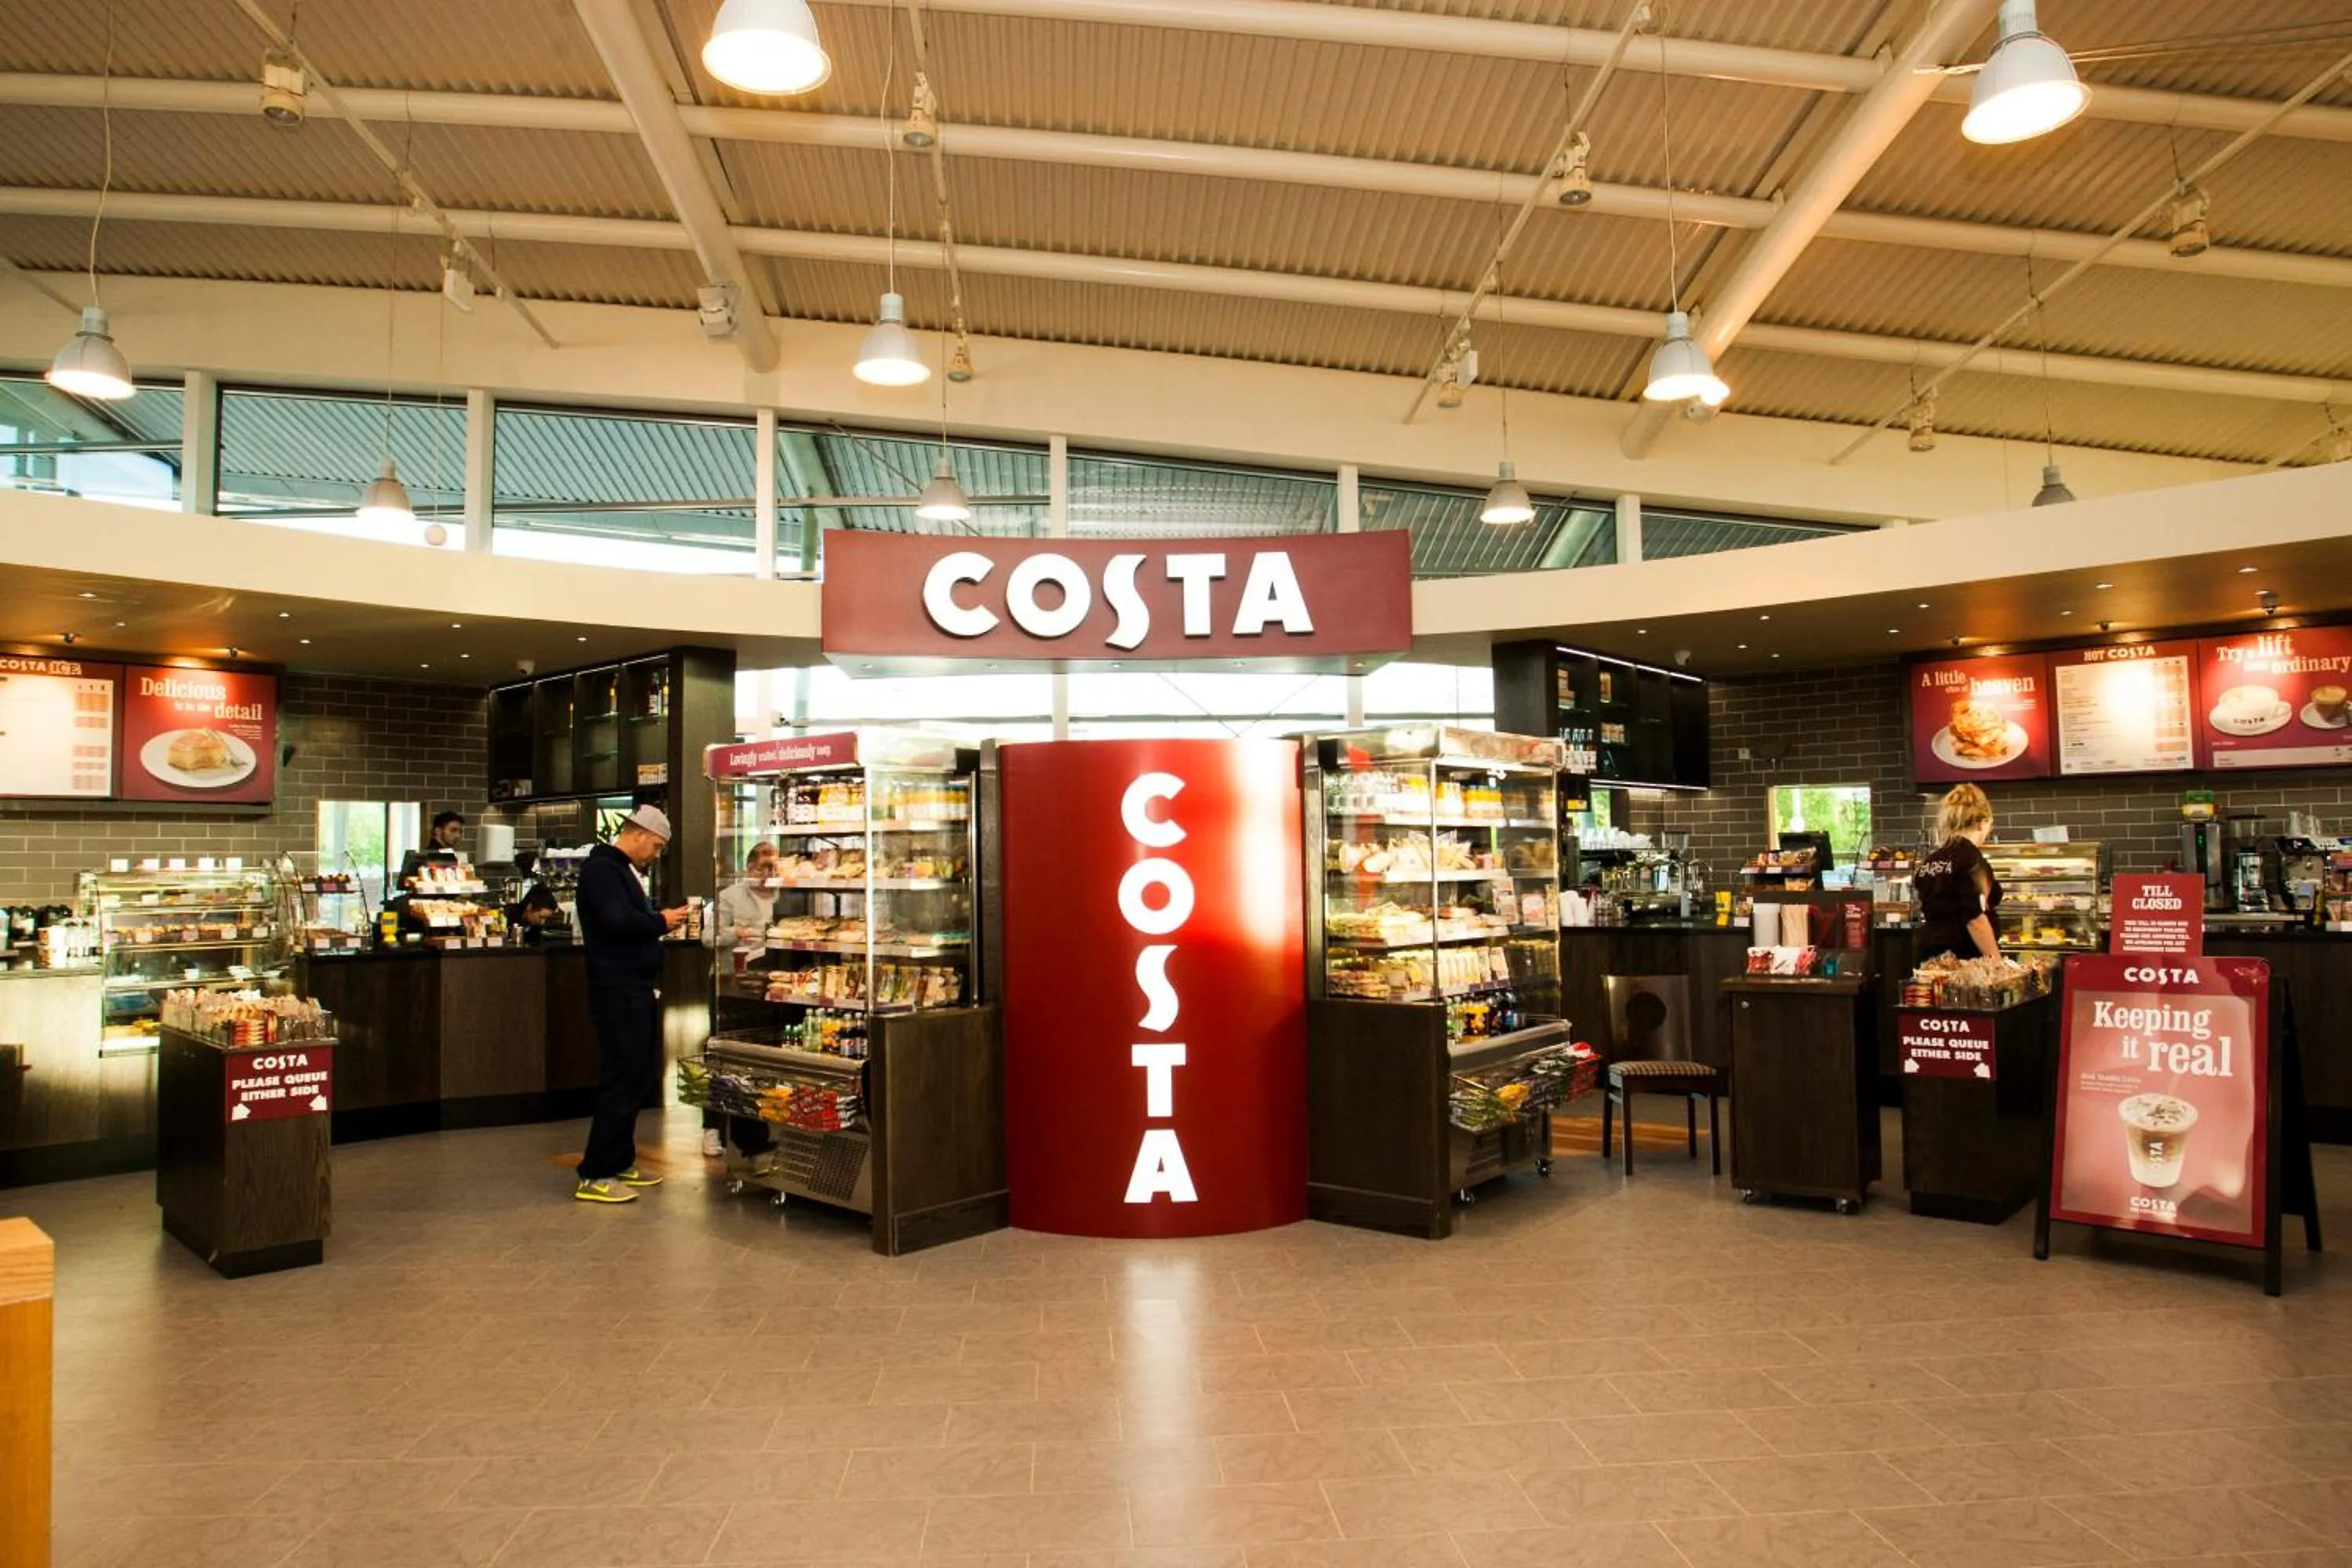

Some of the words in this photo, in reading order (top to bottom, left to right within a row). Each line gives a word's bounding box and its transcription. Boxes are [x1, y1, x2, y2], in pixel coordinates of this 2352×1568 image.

[923, 551, 1315, 651] COSTA
[2084, 650, 2106, 662] HOT
[2107, 645, 2156, 659] COSTA
[2217, 647, 2245, 662] Try
[2257, 633, 2294, 657] lift
[0, 659, 47, 672] COSTA
[2270, 656, 2351, 673] ordinary
[1922, 673, 1932, 688] A
[1935, 670, 1966, 686] little
[1969, 677, 2036, 696] heaven
[140, 677, 227, 700] Delicious
[214, 702, 263, 721] detail
[2141, 885, 2173, 898] TILL
[2132, 898, 2183, 910] CLOSED
[2124, 967, 2200, 985] COSTA
[1117, 771, 1198, 1203] COSTA
[1919, 1018, 1970, 1033] COSTA
[2092, 1000, 2212, 1040] Keeping
[1902, 1036, 1945, 1047] PLEASE
[1948, 1038, 1989, 1050] QUEUE
[252, 1054, 308, 1070] COSTA
[1911, 1048, 1951, 1059] EITHER
[1955, 1051, 1983, 1062] SIDE
[2122, 1035, 2140, 1059] it
[2147, 1036, 2234, 1077] real
[231, 1076, 281, 1090] PLEASE
[284, 1071, 328, 1084] QUEUE
[241, 1088, 286, 1102] EITHER
[289, 1084, 320, 1097] SIDE
[2129, 1196, 2176, 1211] COSTA
